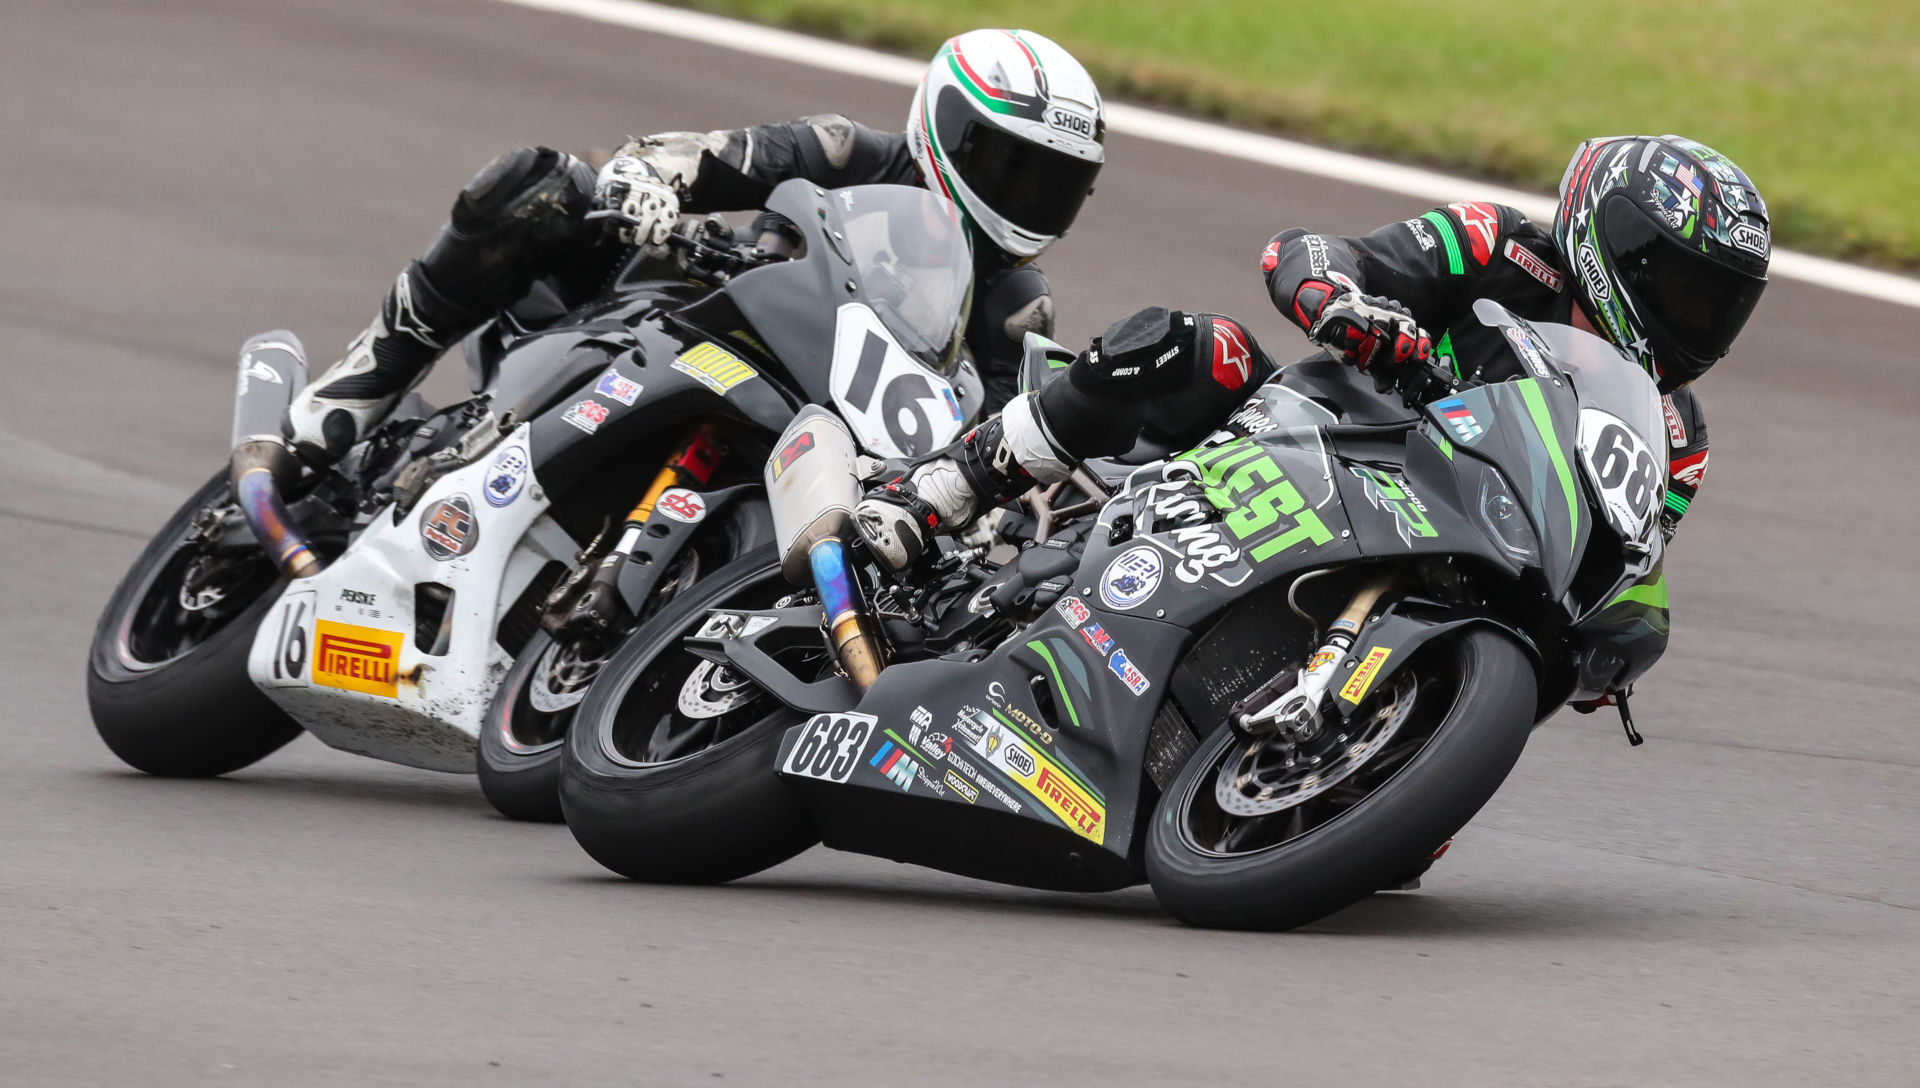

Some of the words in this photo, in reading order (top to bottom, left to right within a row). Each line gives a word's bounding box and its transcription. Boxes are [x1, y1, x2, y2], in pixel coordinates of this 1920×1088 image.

[1509, 243, 1561, 289] PIRELLI
[1581, 250, 1607, 294] SHOEI
[1111, 367, 1133, 377] COMP
[1155, 345, 1180, 369] STREET
[844, 328, 938, 459] 16
[660, 492, 703, 518] sbs
[1394, 479, 1428, 513] S1000
[1068, 599, 1089, 621] CCS
[273, 600, 308, 680] 16
[1082, 622, 1116, 654] AMA
[318, 633, 393, 684] PIRELLI
[1344, 651, 1386, 697] PIRELLI
[1123, 667, 1146, 692] ASRA
[1004, 703, 1053, 745] MOTO-D
[790, 714, 870, 781] 683
[921, 736, 947, 761] Valley
[1007, 747, 1032, 774] SHOEI
[1036, 766, 1102, 835] PIRELLI
